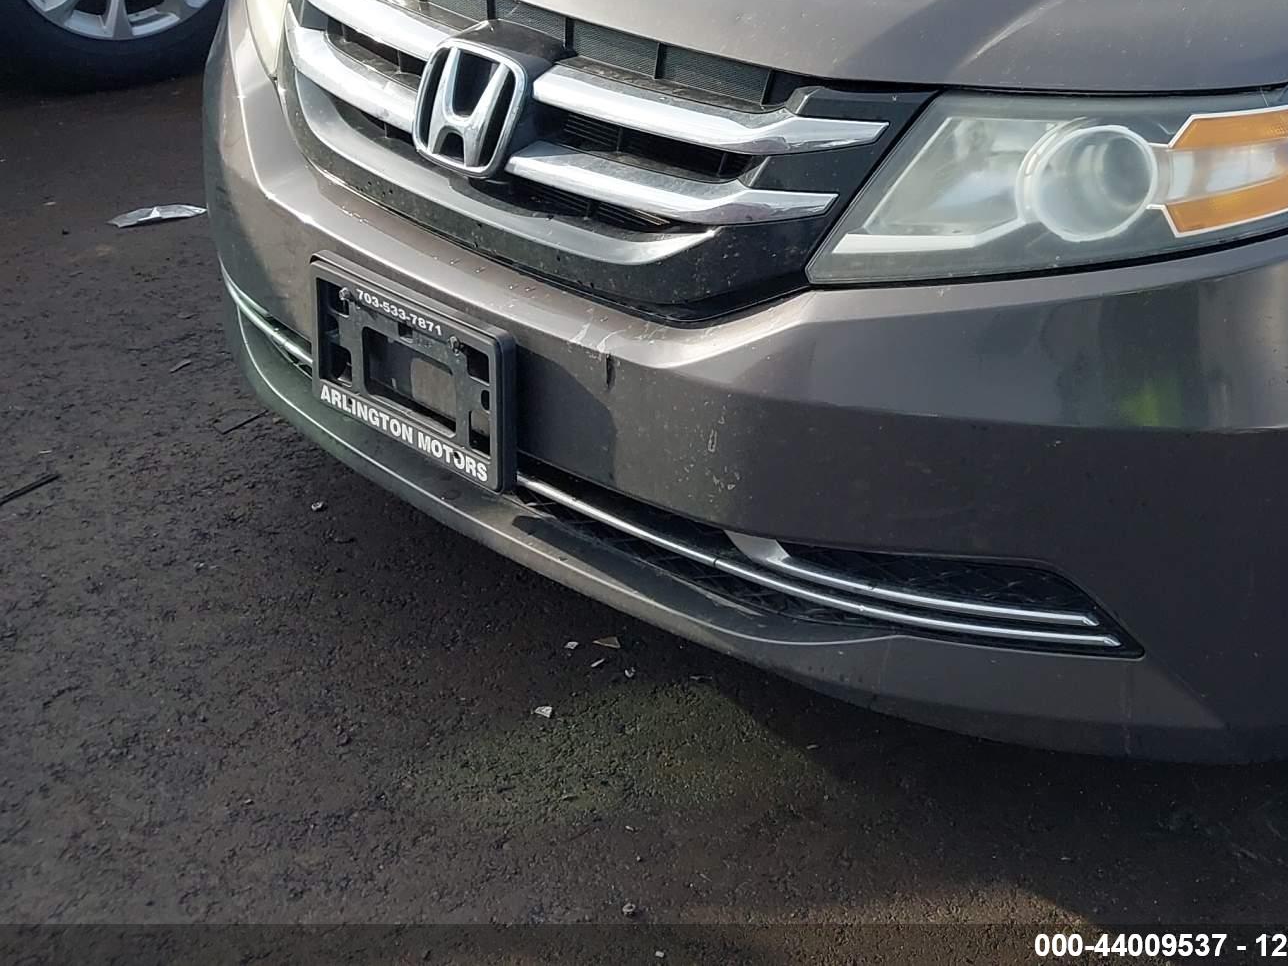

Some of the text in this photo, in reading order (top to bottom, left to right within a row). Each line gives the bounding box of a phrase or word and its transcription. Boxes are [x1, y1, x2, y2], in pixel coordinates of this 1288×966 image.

[355, 288, 444, 337] 703-533-7871
[319, 384, 488, 482] ARLINGTON MOTORS
